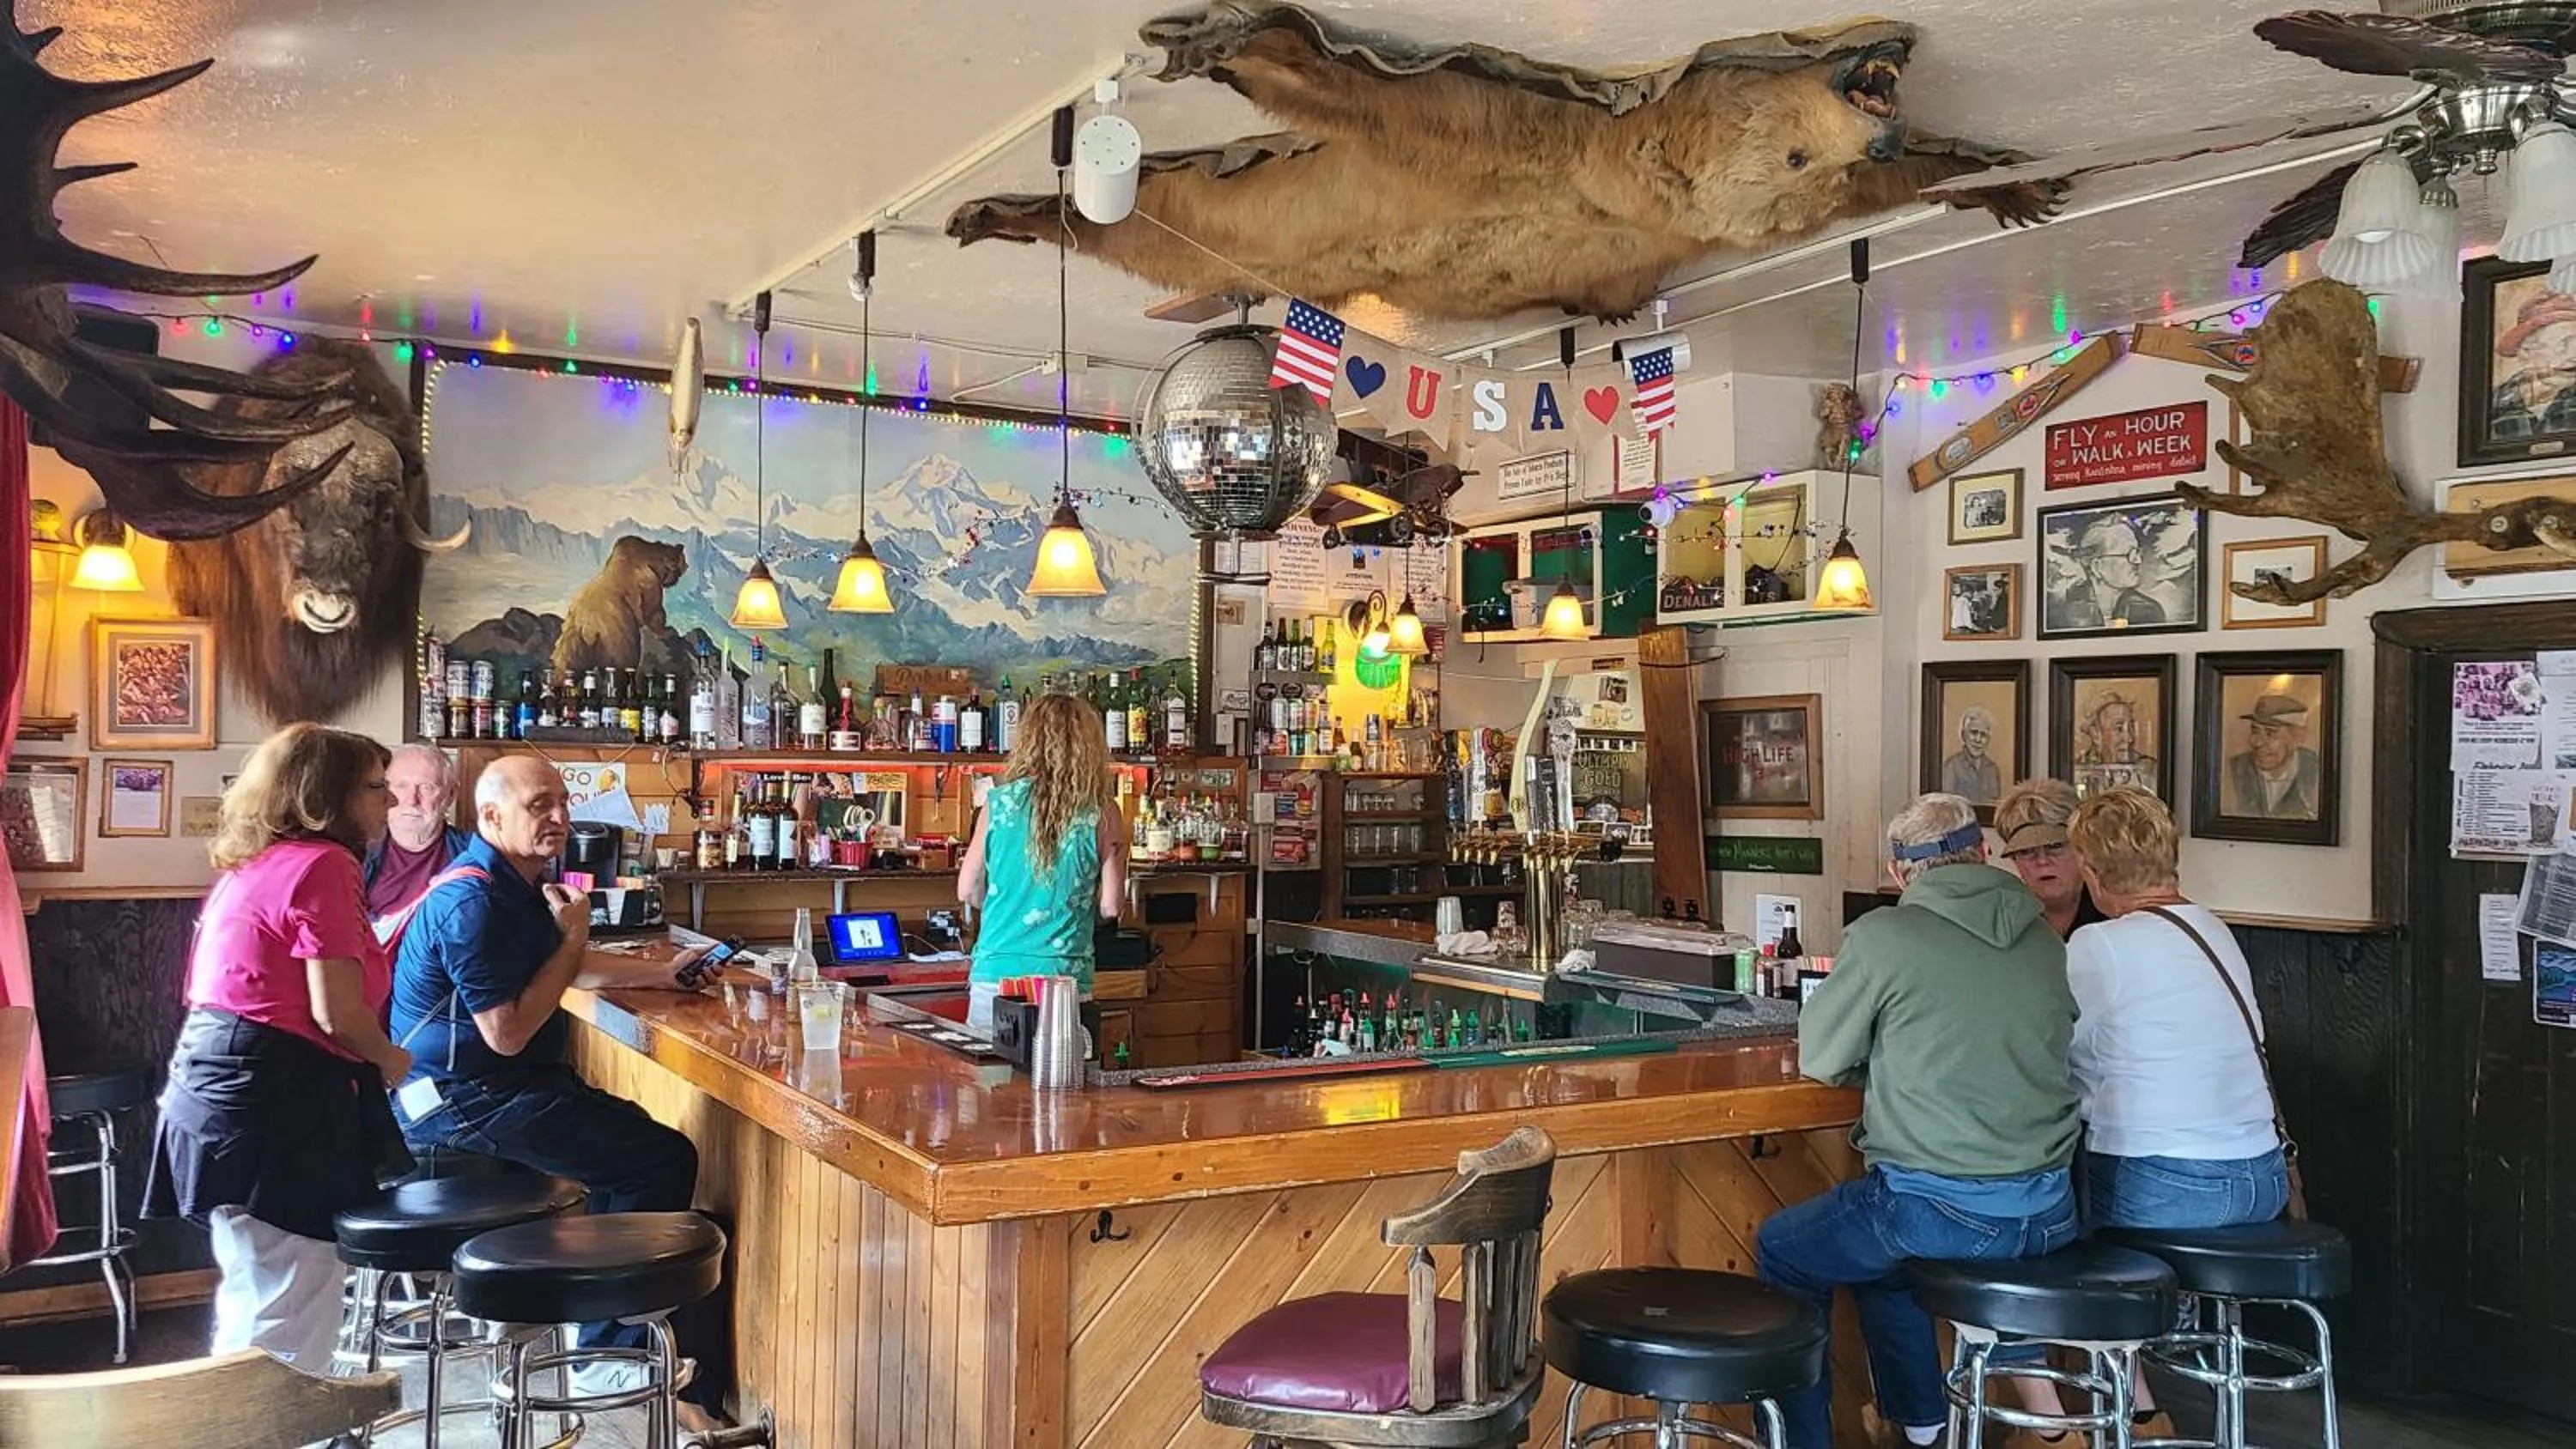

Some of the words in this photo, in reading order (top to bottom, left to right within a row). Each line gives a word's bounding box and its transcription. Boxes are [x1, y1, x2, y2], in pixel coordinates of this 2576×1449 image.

[1406, 365, 1564, 432] USA
[2053, 425, 2098, 451] FLY
[2125, 411, 2185, 435] HOUR
[2072, 443, 2123, 465] WALK
[2136, 434, 2191, 457] WEEK
[1722, 746, 1759, 764] HIGH
[1764, 746, 1794, 763] LIFE
